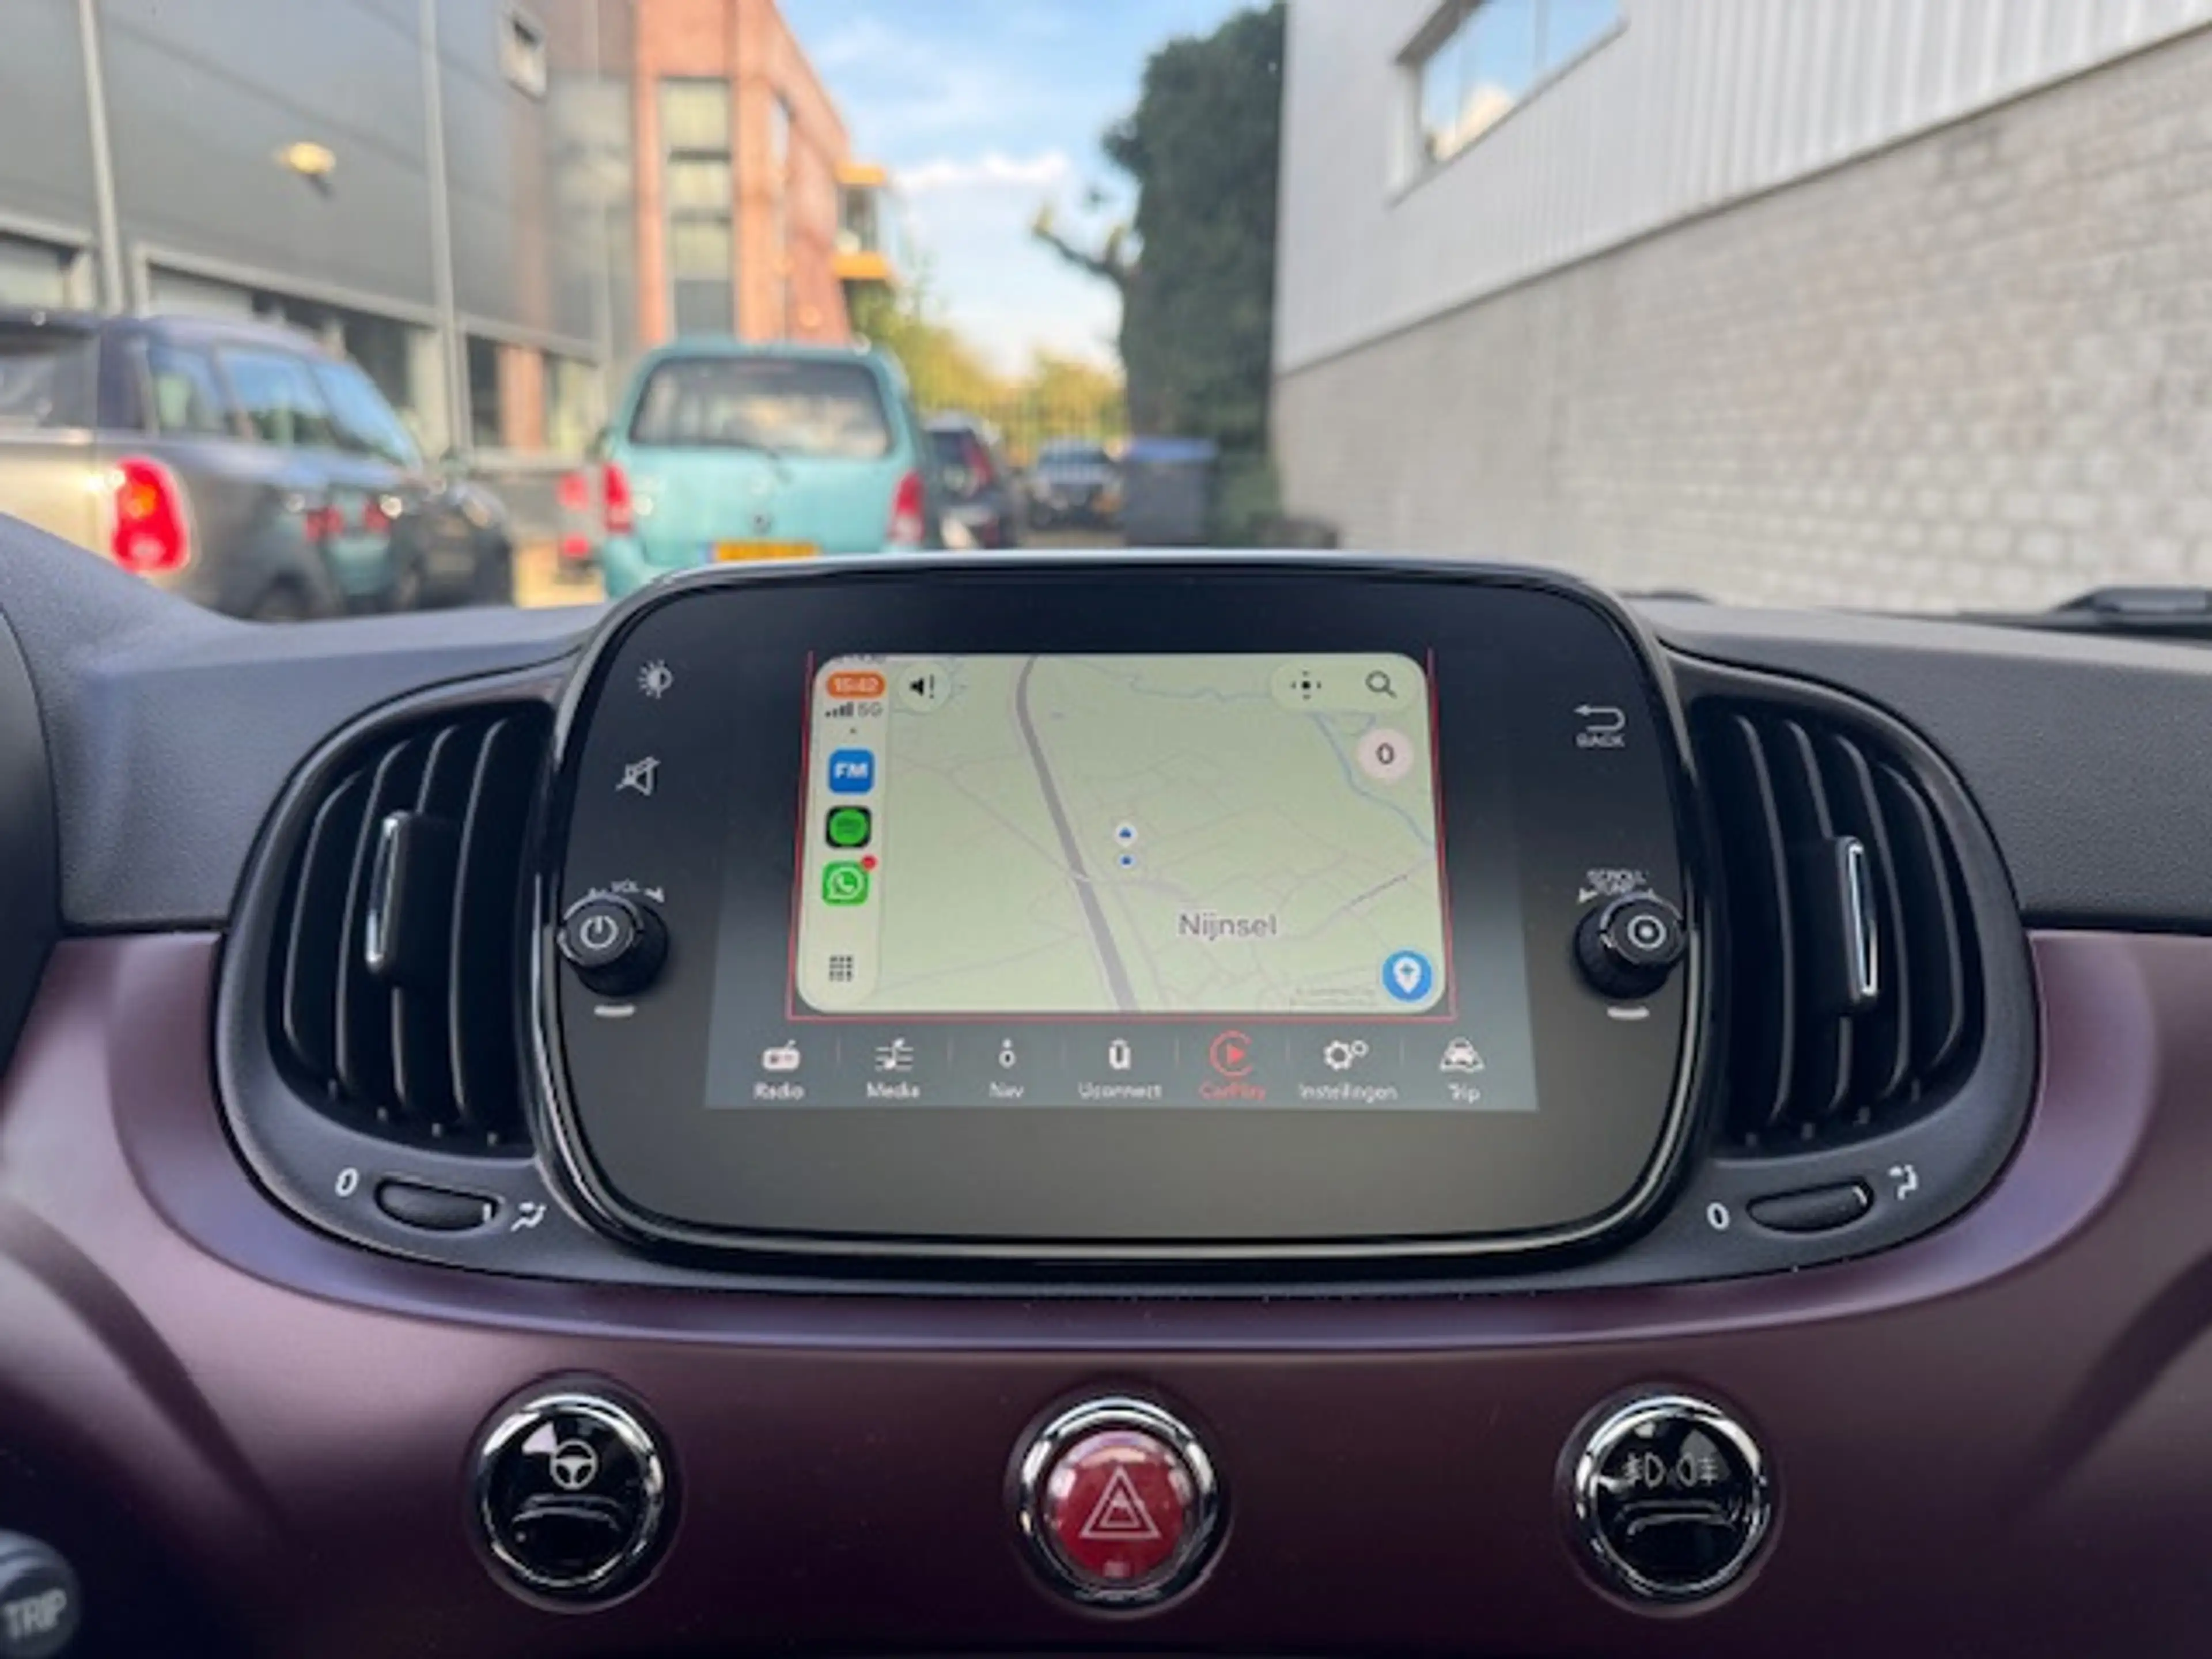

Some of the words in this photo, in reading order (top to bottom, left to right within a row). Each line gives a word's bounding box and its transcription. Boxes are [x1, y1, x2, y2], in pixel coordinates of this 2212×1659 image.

[1376, 743, 1395, 765] 0
[834, 762, 869, 779] FM
[1179, 912, 1278, 941] Nijnsel
[866, 1081, 921, 1099] Media
[988, 1081, 1025, 1099] Nav
[5, 1589, 67, 1639] TRIP
